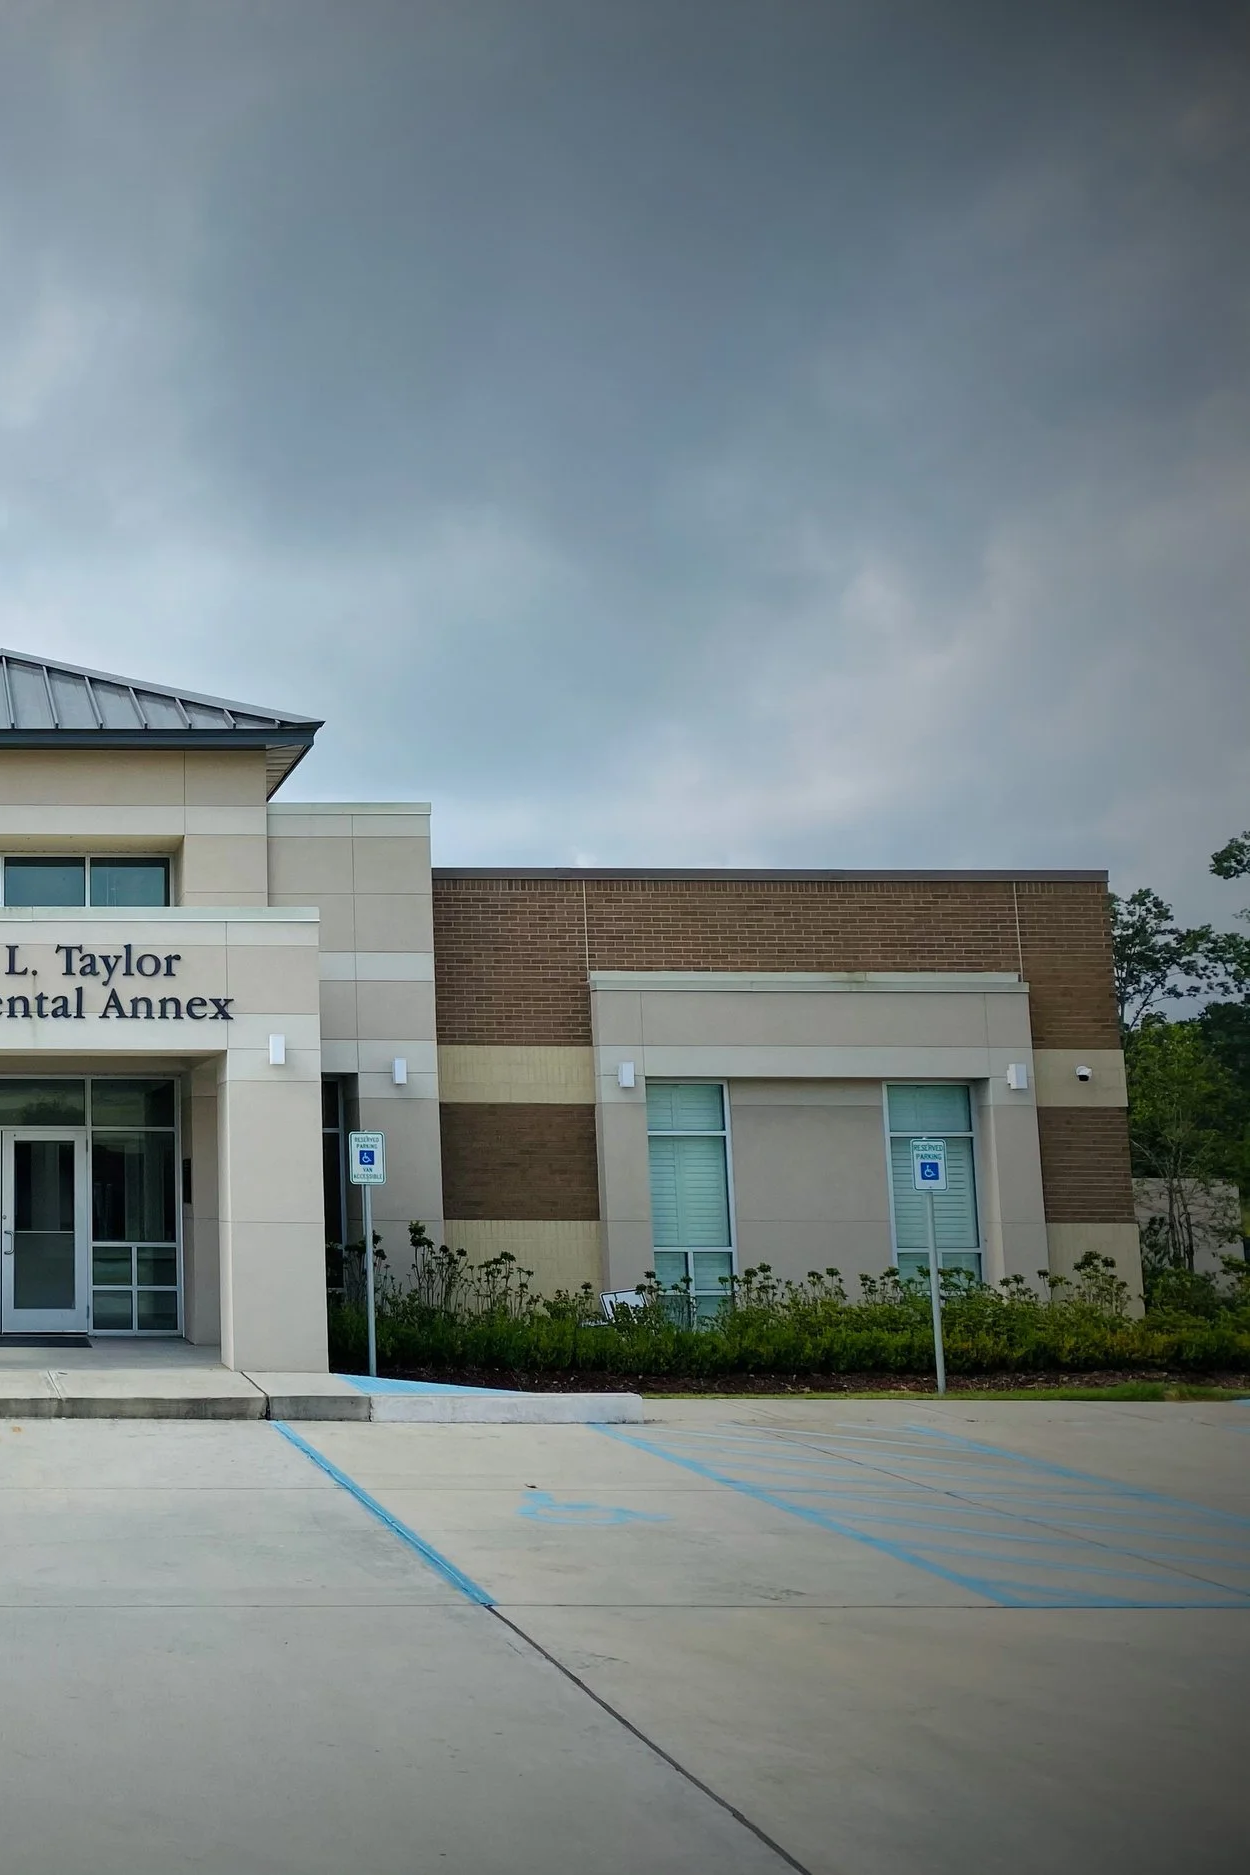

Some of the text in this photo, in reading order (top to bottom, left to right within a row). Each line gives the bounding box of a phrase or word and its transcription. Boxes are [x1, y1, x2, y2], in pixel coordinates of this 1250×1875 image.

[5, 944, 38, 977] L.
[55, 943, 182, 986] Taylor
[98, 987, 235, 1021] Annex
